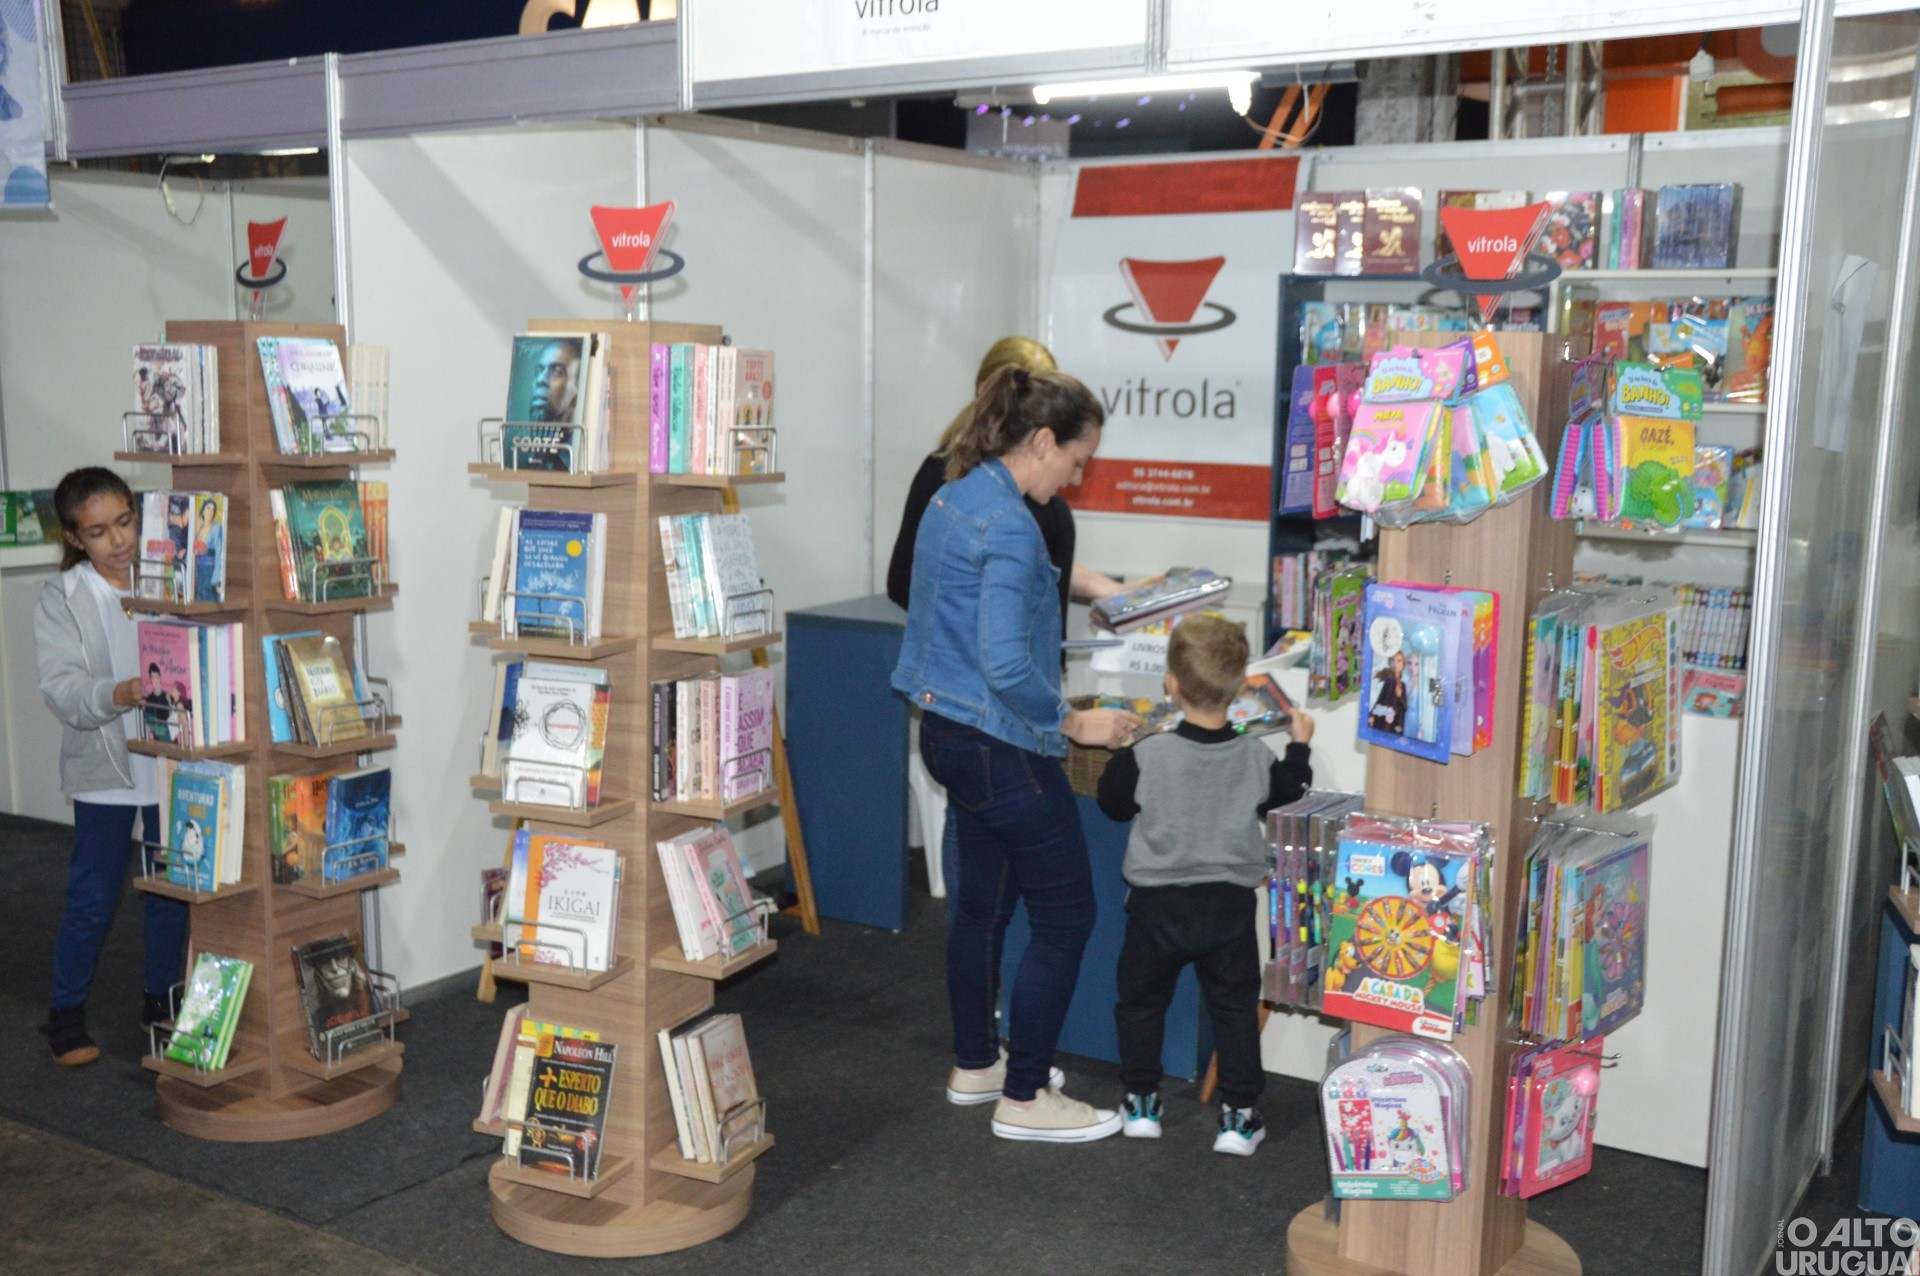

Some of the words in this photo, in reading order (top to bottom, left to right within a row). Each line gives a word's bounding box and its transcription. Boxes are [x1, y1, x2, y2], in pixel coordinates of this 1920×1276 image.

[612, 230, 650, 248] vitrola
[1468, 234, 1517, 253] vitrola
[1372, 373, 1423, 394] BANHO!
[1101, 377, 1235, 419] vitrola
[1622, 383, 1671, 409] BANHO!
[1428, 605, 1457, 617] FROZEN
[1132, 642, 1166, 654] LIVROS
[1129, 660, 1141, 670] R$
[738, 707, 764, 733] ASSIM
[737, 731, 755, 753] QUE
[548, 895, 600, 916] IKIGAI
[1361, 980, 1369, 992] A
[1370, 980, 1401, 999] CASA
[1355, 993, 1388, 1005] MICKEY
[1390, 1000, 1423, 1012] MOUSE
[554, 1040, 593, 1059] NAPOLEON
[594, 1047, 613, 1063] HILL
[558, 1069, 601, 1094] ESPERTO
[534, 1087, 557, 1111] QUE
[556, 1091, 566, 1110] O
[566, 1093, 599, 1116] DIABO
